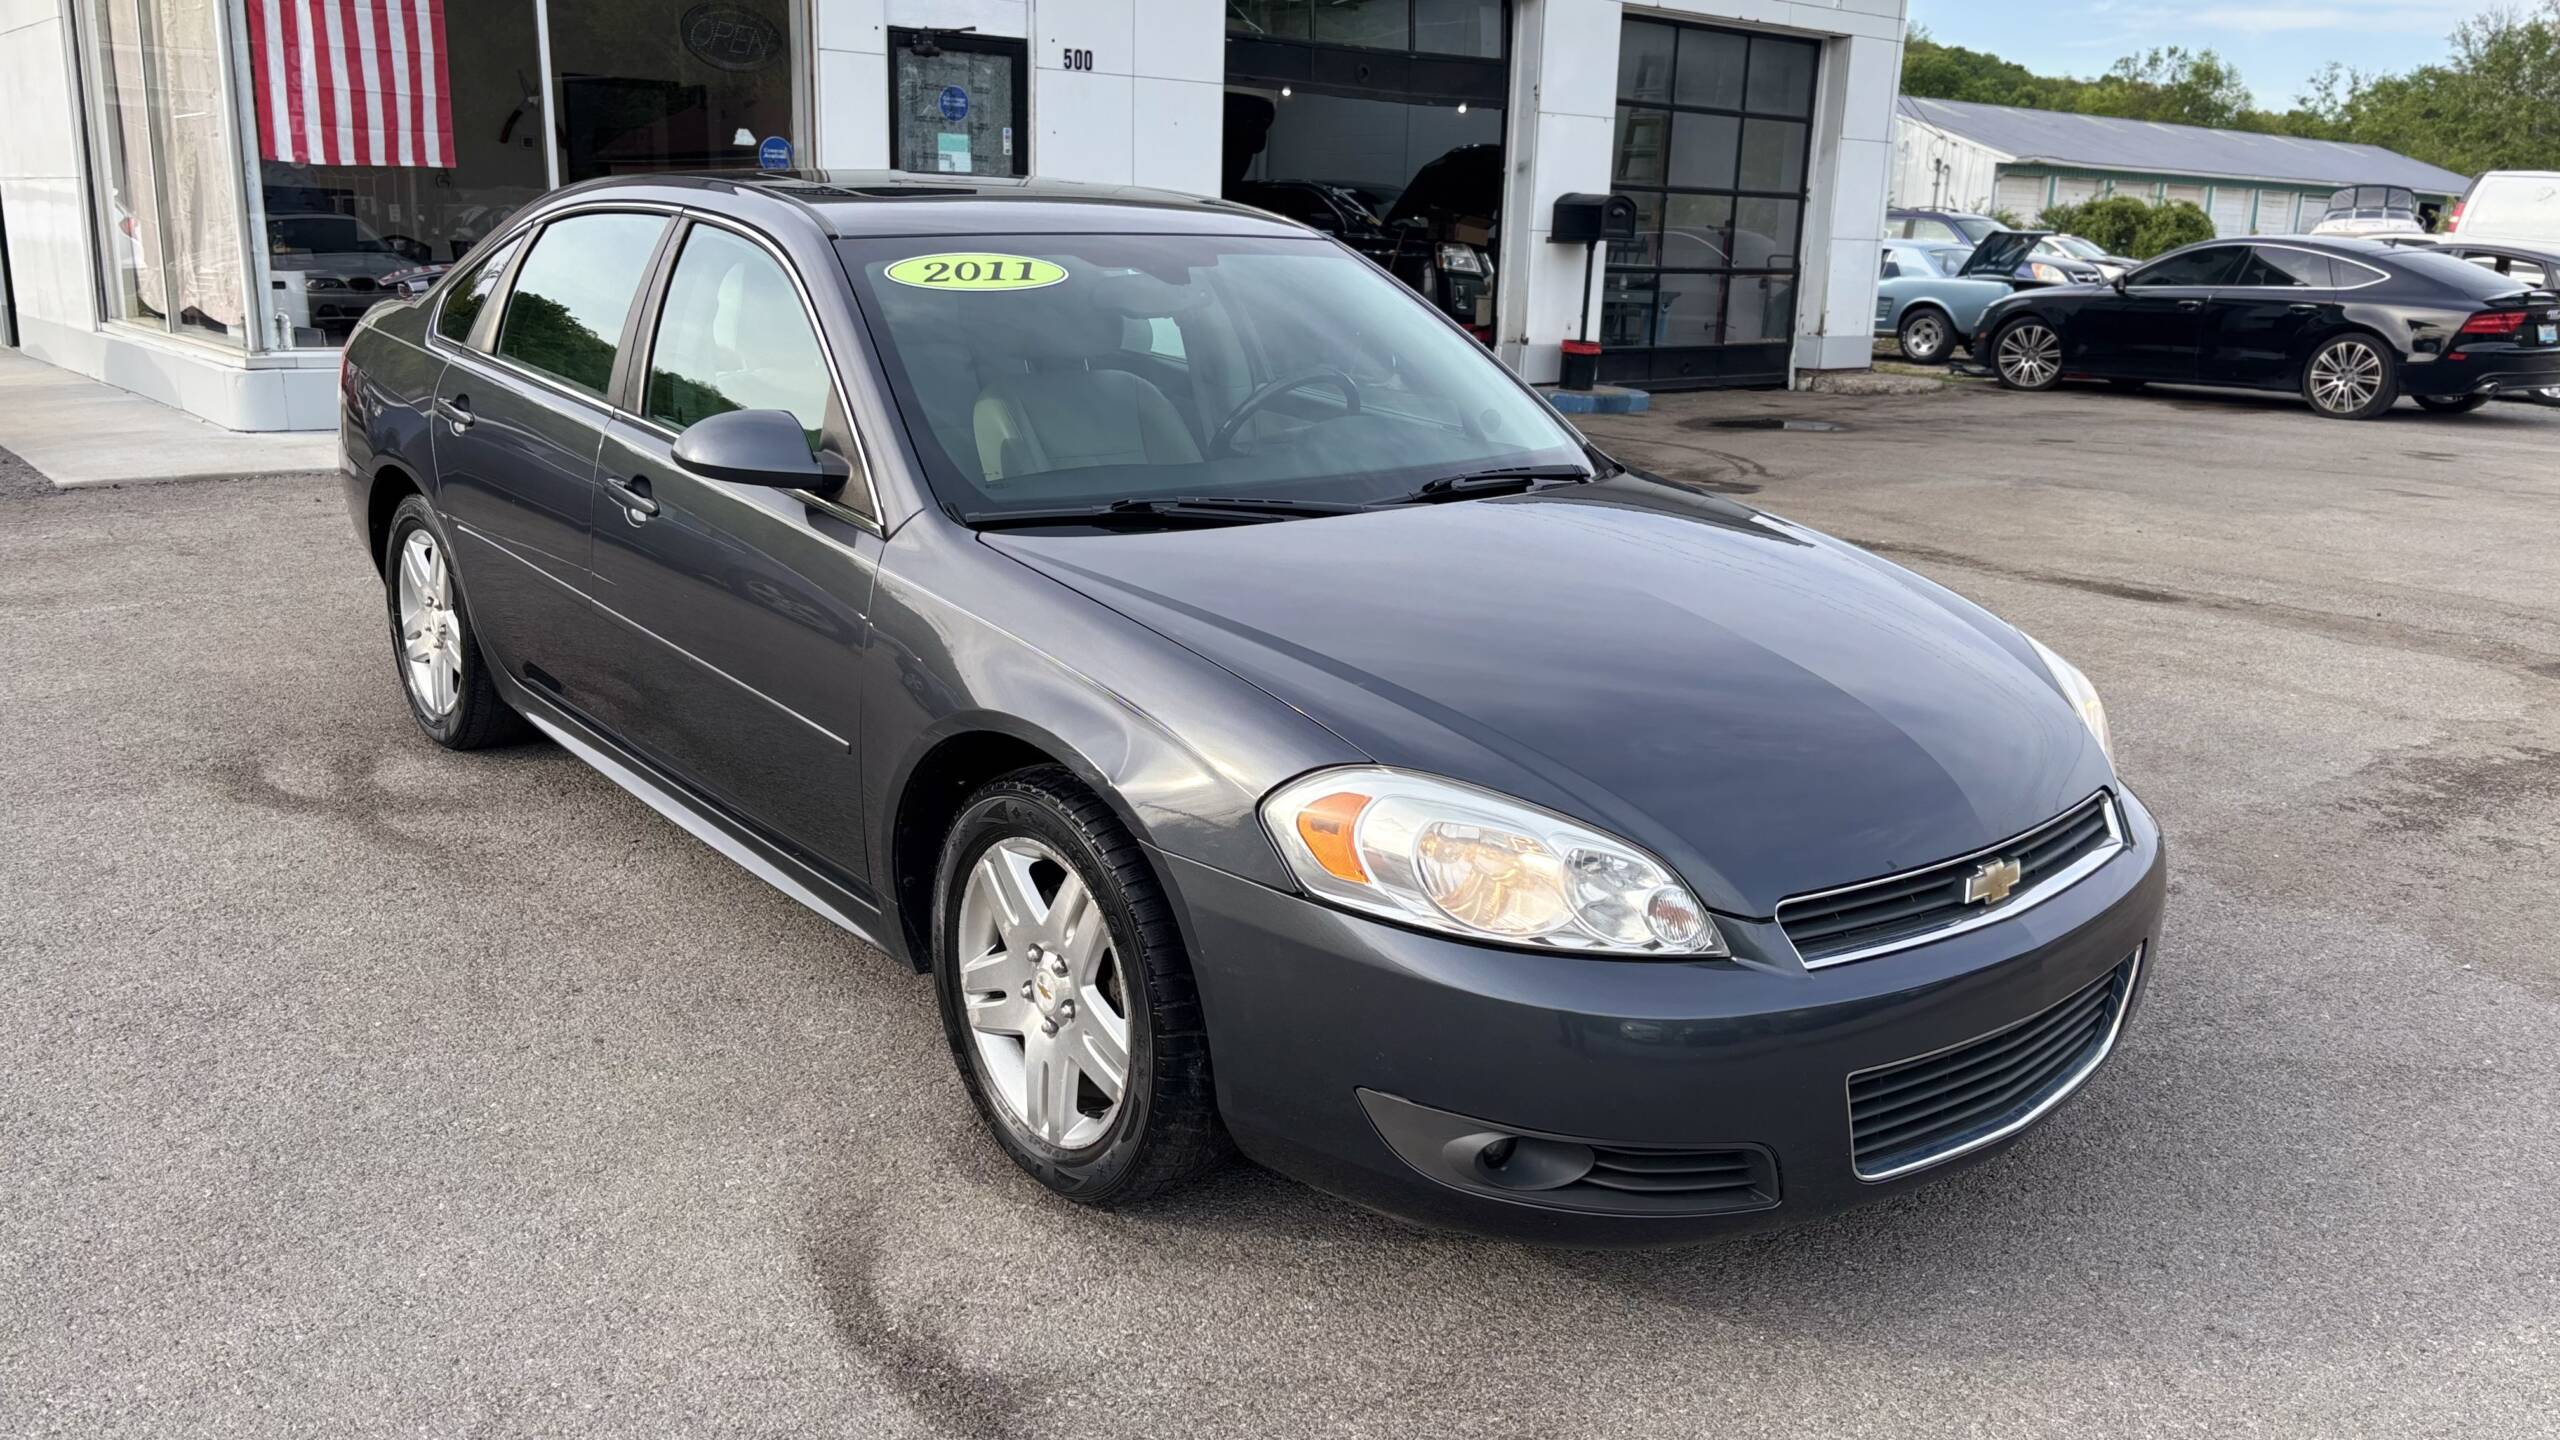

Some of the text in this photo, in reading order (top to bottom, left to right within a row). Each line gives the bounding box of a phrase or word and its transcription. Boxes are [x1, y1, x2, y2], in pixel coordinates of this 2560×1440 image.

[690, 17, 774, 55] OPEN
[1063, 48, 1093, 71] 500
[923, 261, 1036, 283] 2011
